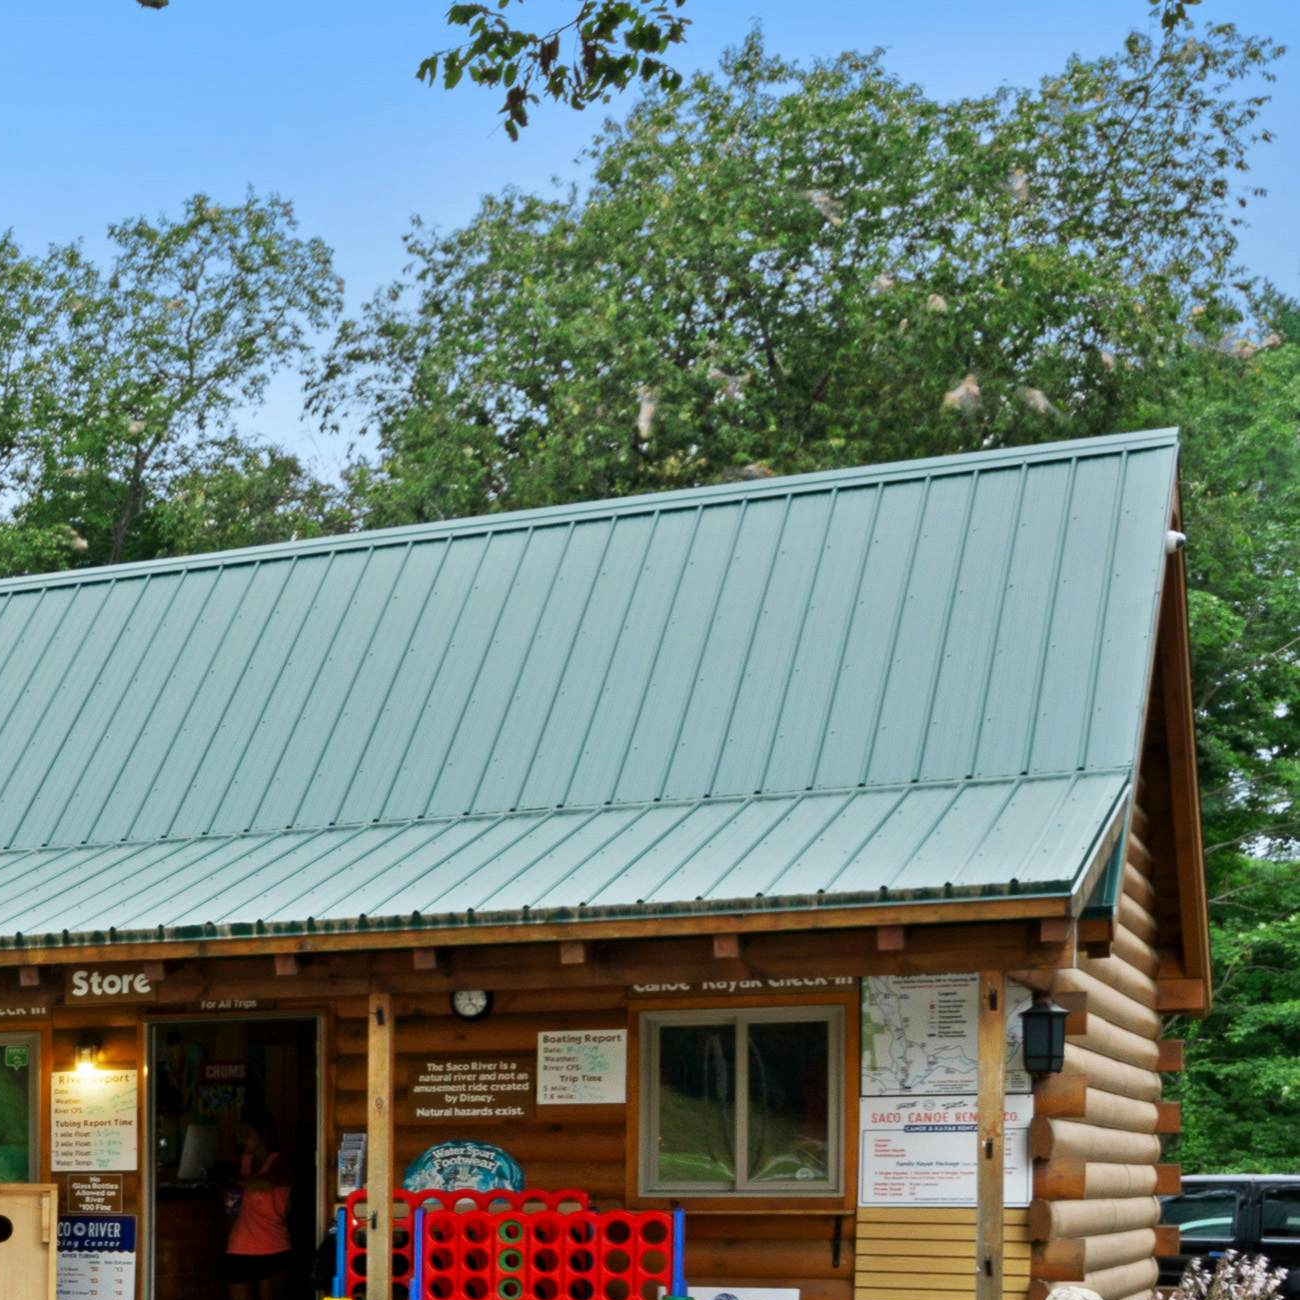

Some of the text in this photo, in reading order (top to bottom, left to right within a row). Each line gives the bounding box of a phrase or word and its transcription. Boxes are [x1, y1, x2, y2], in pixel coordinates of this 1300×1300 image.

[72, 970, 150, 997] Store
[201, 999, 257, 1009] For All Trips
[543, 1034, 622, 1045] Boating Report
[427, 1061, 516, 1071] The Saco River is a
[58, 1075, 87, 1084] Rive
[419, 1073, 452, 1082] natural
[453, 1072, 476, 1081] river
[479, 1072, 496, 1080] and
[498, 1072, 514, 1080] not
[560, 1074, 602, 1083] Trip Time
[413, 1082, 529, 1093] amusement ride created
[445, 1093, 496, 1104] by Disney.
[416, 1106, 525, 1117] Natural hazards exist.
[55, 1118, 133, 1128] Tubing Report Time
[872, 1111, 902, 1124] SACO
[908, 1111, 948, 1123] CANOE
[955, 1111, 978, 1122] REN
[432, 1145, 496, 1160] Water Sport
[434, 1157, 501, 1173] Footwear!
[57, 1222, 121, 1238] CO RIVER
[84, 1239, 121, 1247] Center
